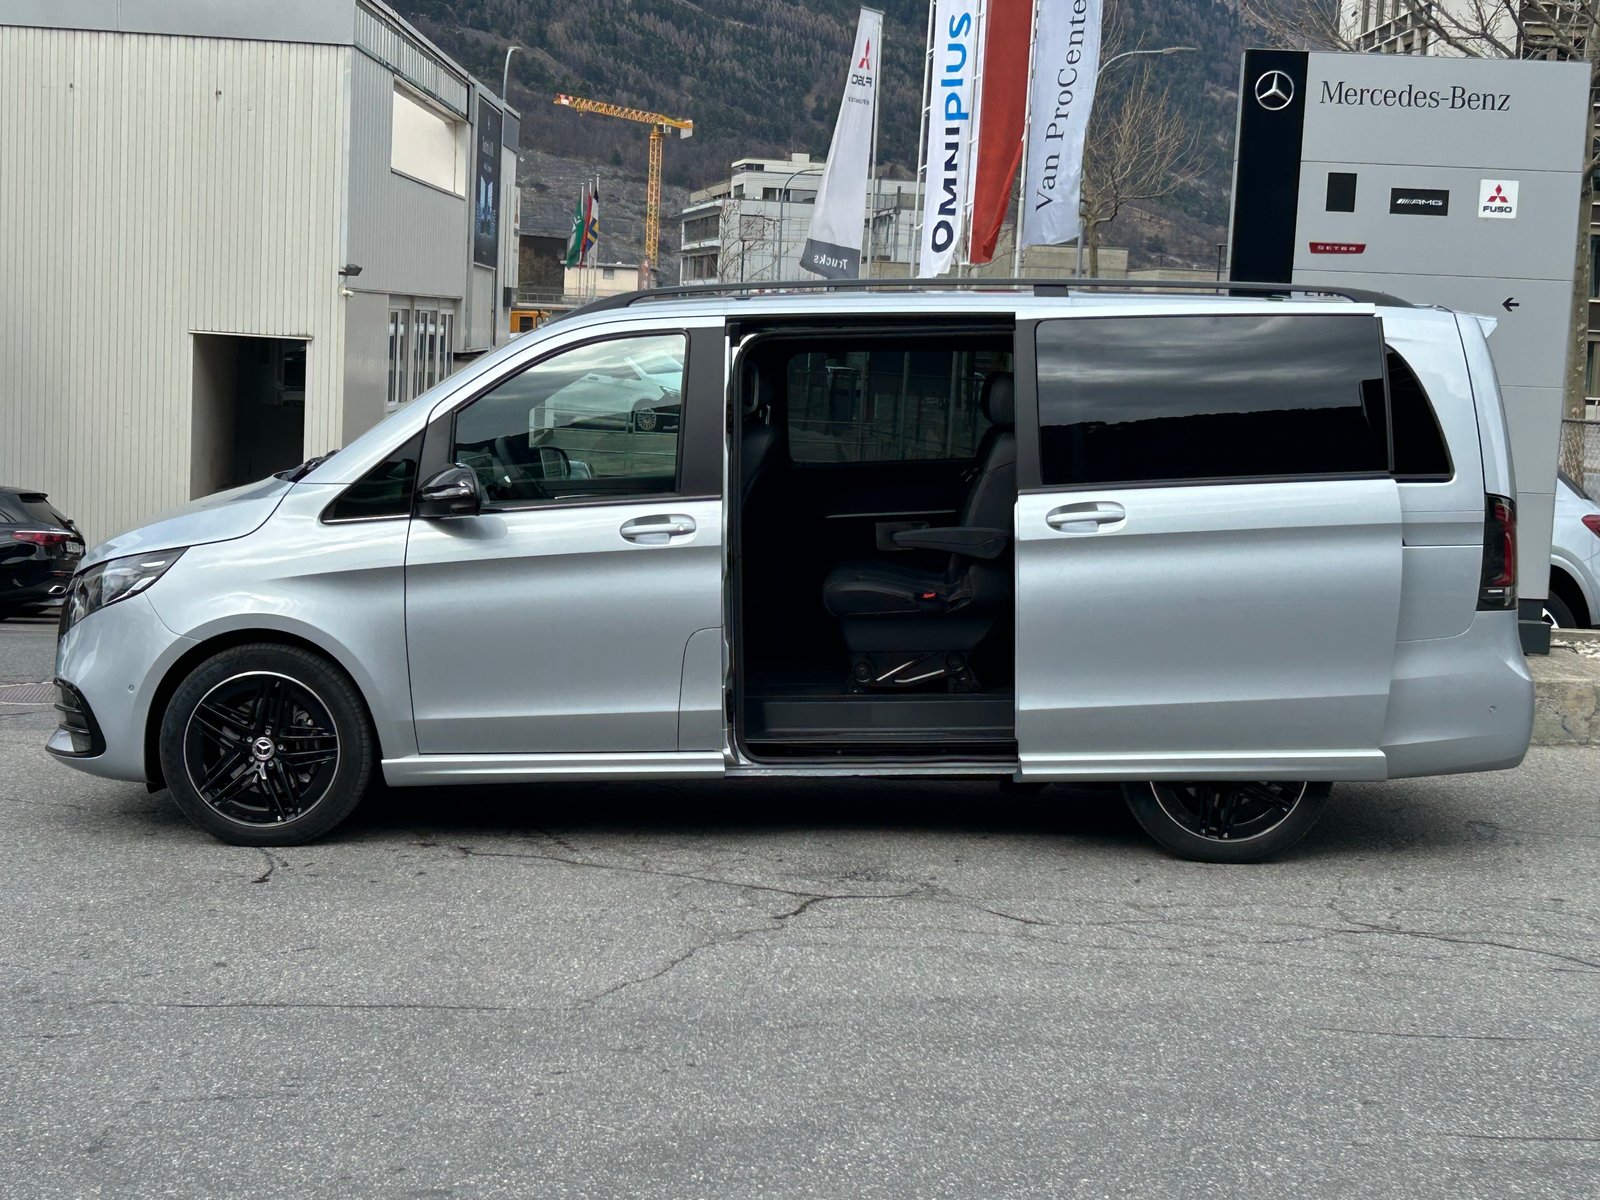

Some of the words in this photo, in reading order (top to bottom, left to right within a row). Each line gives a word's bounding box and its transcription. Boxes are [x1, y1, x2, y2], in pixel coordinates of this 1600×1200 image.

[1320, 80, 1511, 112] Mercedes-Benz
[1035, 153, 1060, 212] Van
[1482, 205, 1512, 213] FUSO
